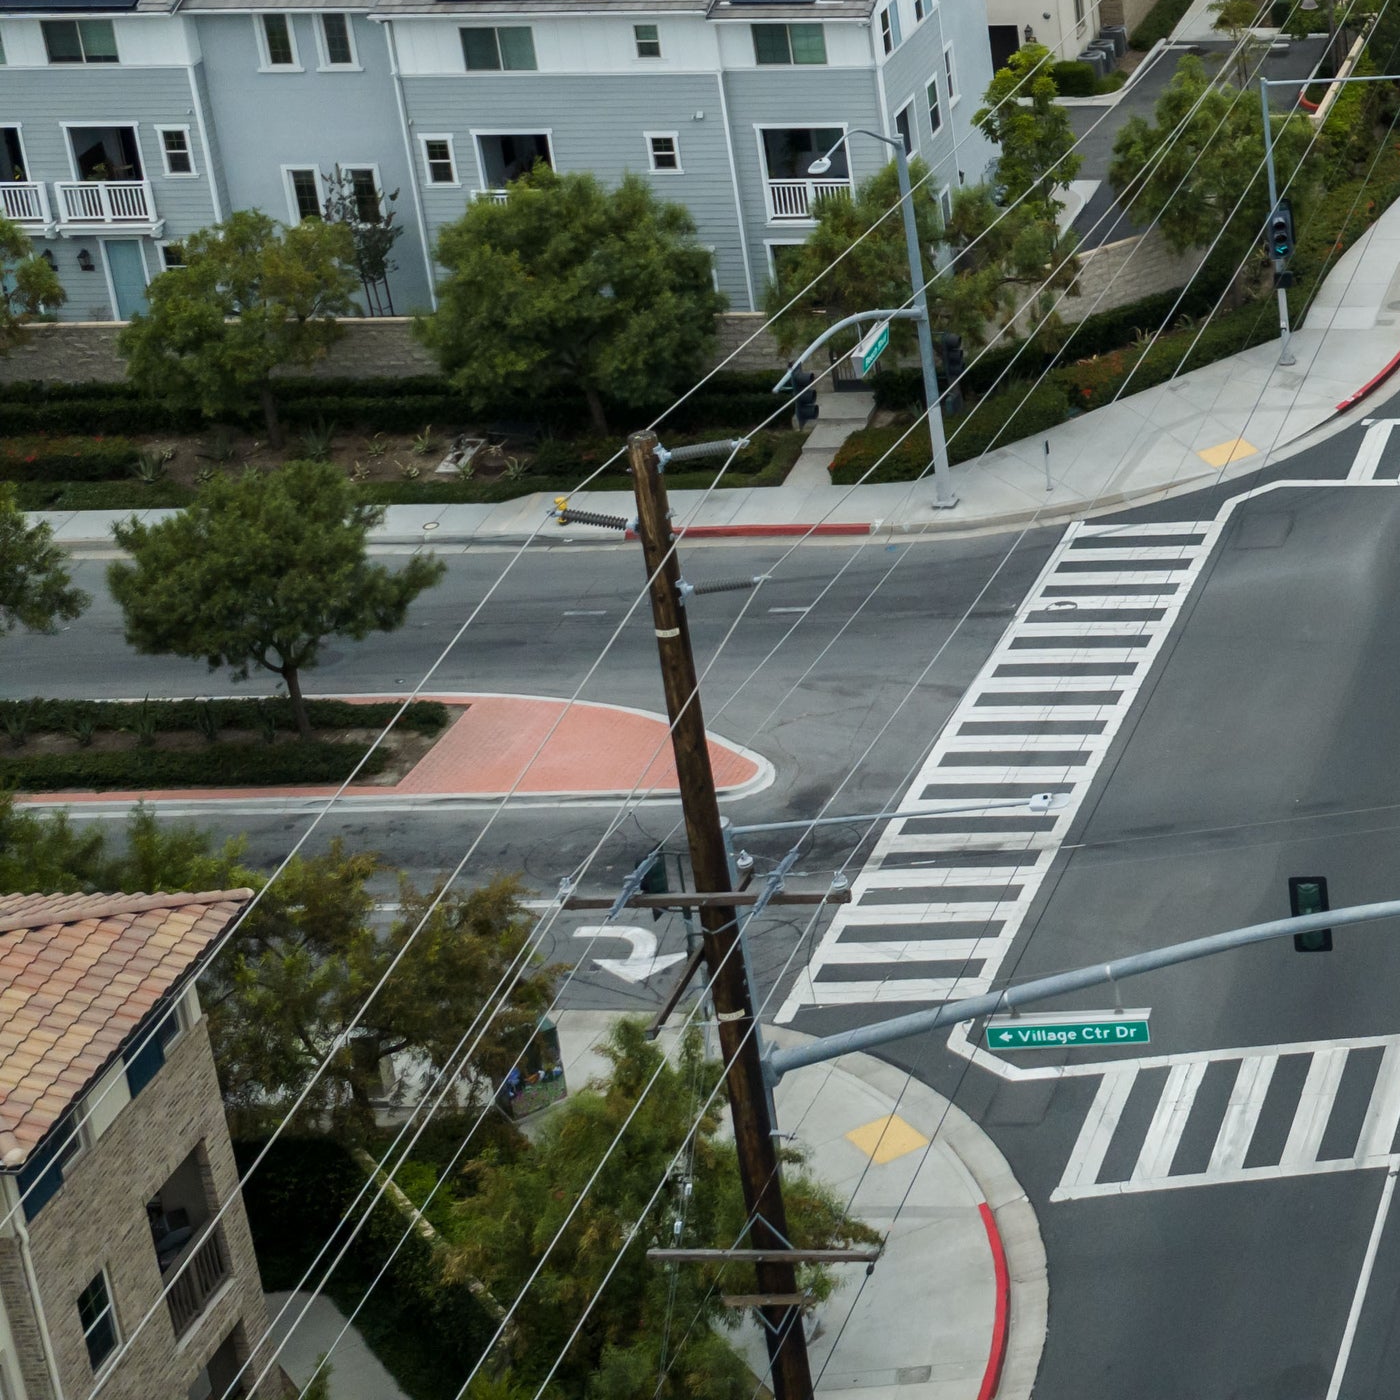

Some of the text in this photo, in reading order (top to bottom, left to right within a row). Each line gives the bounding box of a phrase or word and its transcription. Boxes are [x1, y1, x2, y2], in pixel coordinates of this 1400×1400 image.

[1017, 1026, 1137, 1045] Village Ctr Dr
